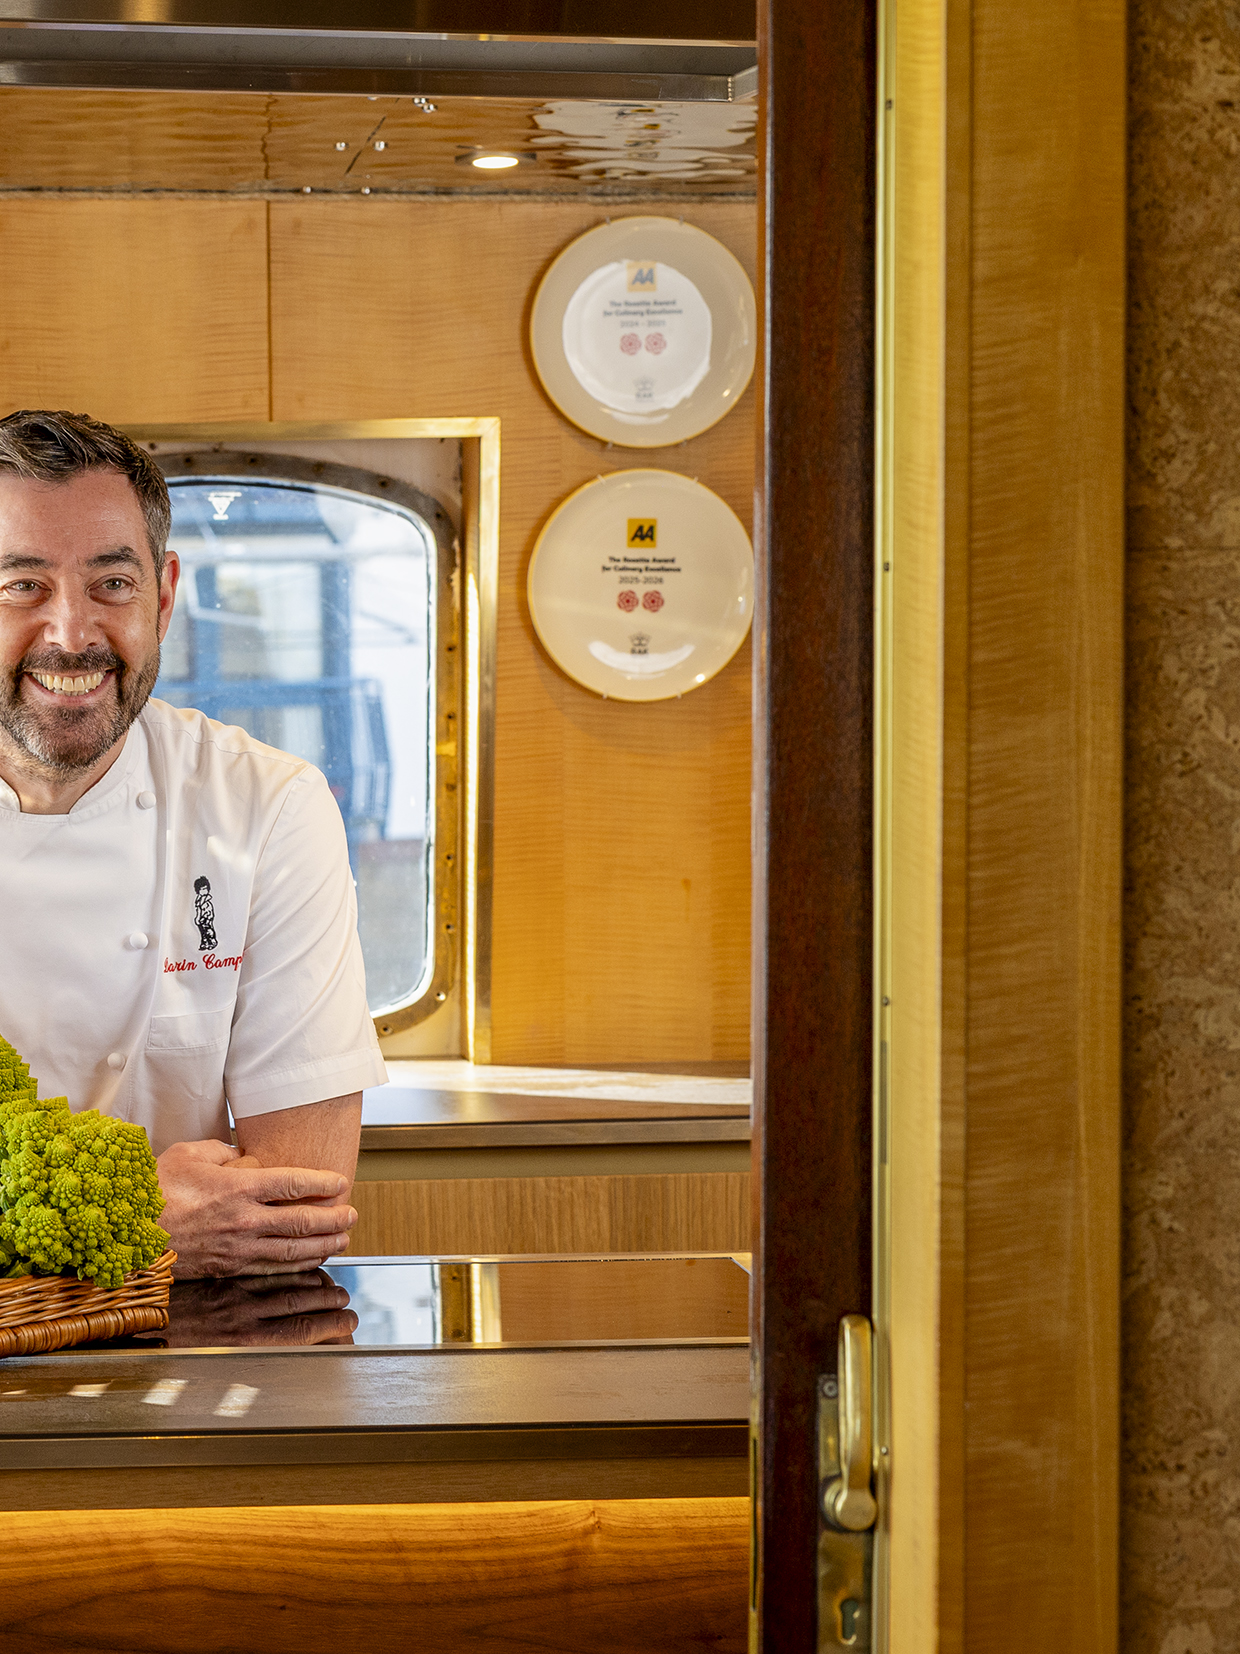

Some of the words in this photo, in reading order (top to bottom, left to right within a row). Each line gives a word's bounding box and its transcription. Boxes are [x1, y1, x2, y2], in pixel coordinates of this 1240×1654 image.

[631, 267, 655, 285] AA
[603, 309, 613, 317] for
[615, 309, 644, 317] Culinary
[631, 524, 655, 542] AA
[602, 565, 611, 573] for
[614, 565, 643, 573] Culinary
